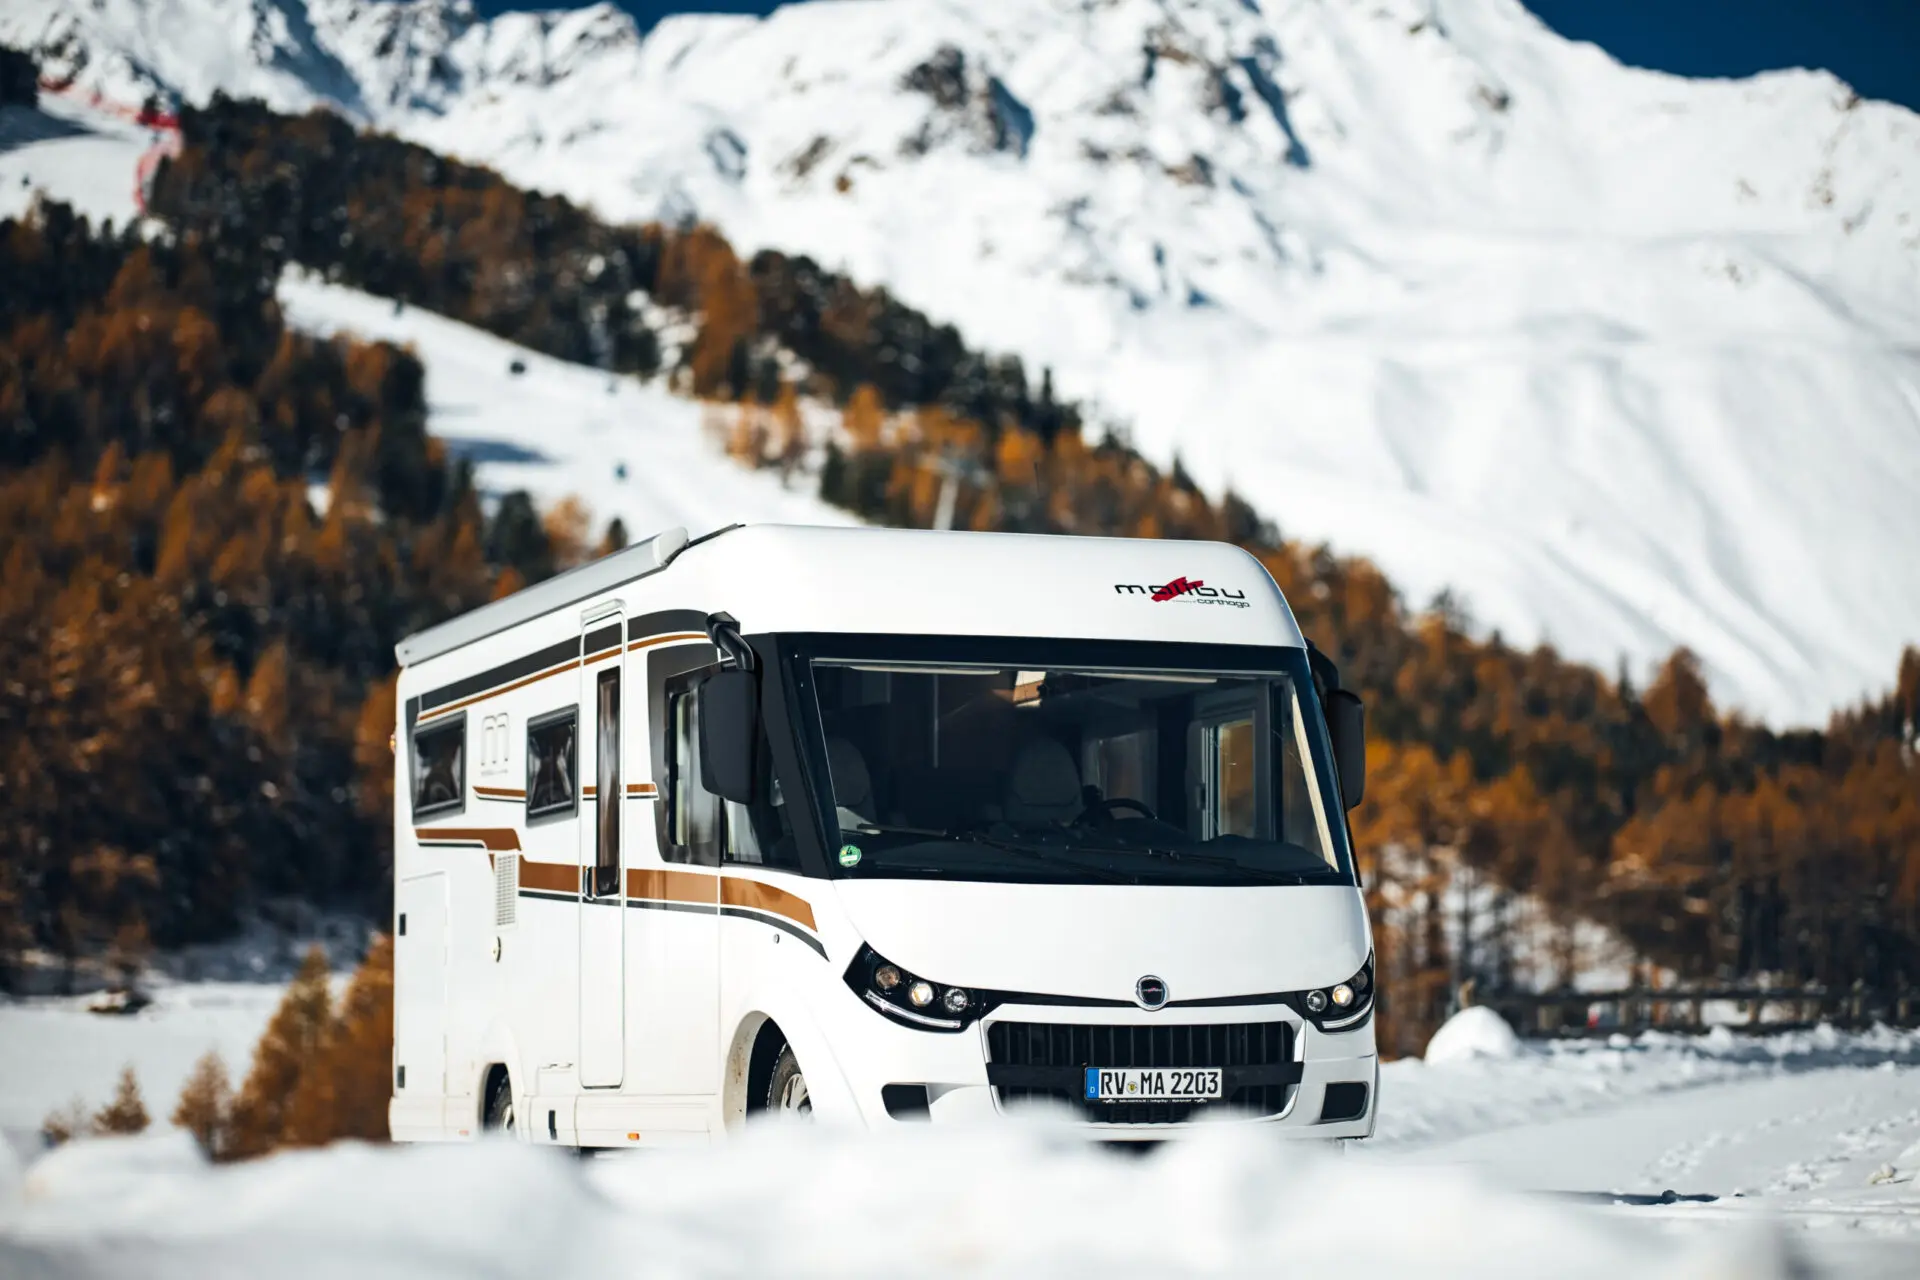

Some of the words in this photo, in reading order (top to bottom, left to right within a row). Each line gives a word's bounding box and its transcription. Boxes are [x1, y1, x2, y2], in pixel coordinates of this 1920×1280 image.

[1114, 583, 1245, 599] malibu
[1101, 1072, 1126, 1095] RV
[1140, 1072, 1165, 1095] MA
[1171, 1072, 1218, 1095] 2203
